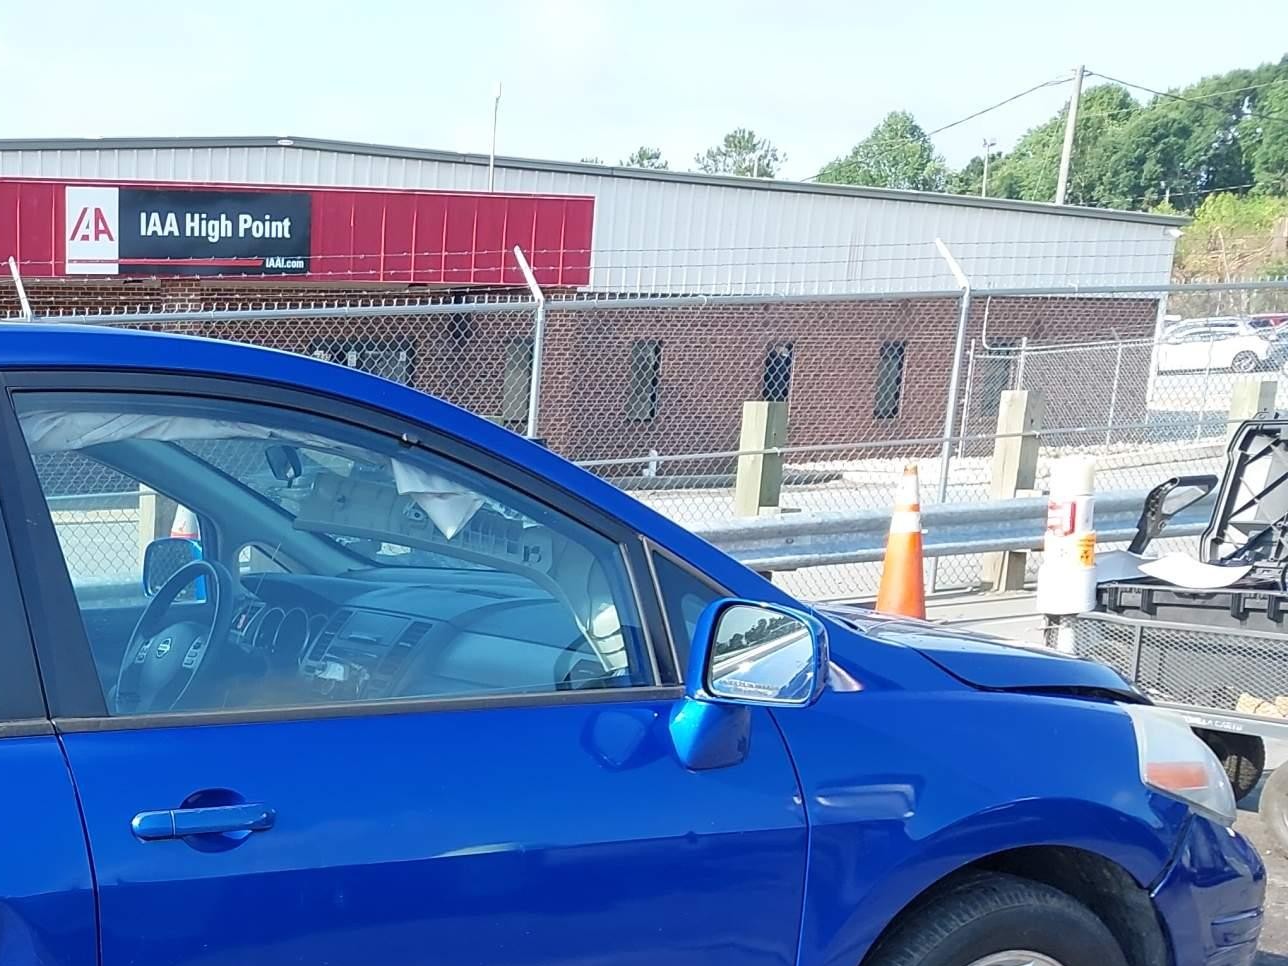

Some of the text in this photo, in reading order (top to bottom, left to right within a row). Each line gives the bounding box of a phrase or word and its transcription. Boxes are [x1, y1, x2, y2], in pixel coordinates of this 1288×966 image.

[140, 212, 291, 243] IAA High Point
[265, 256, 305, 269] IAAI.com
